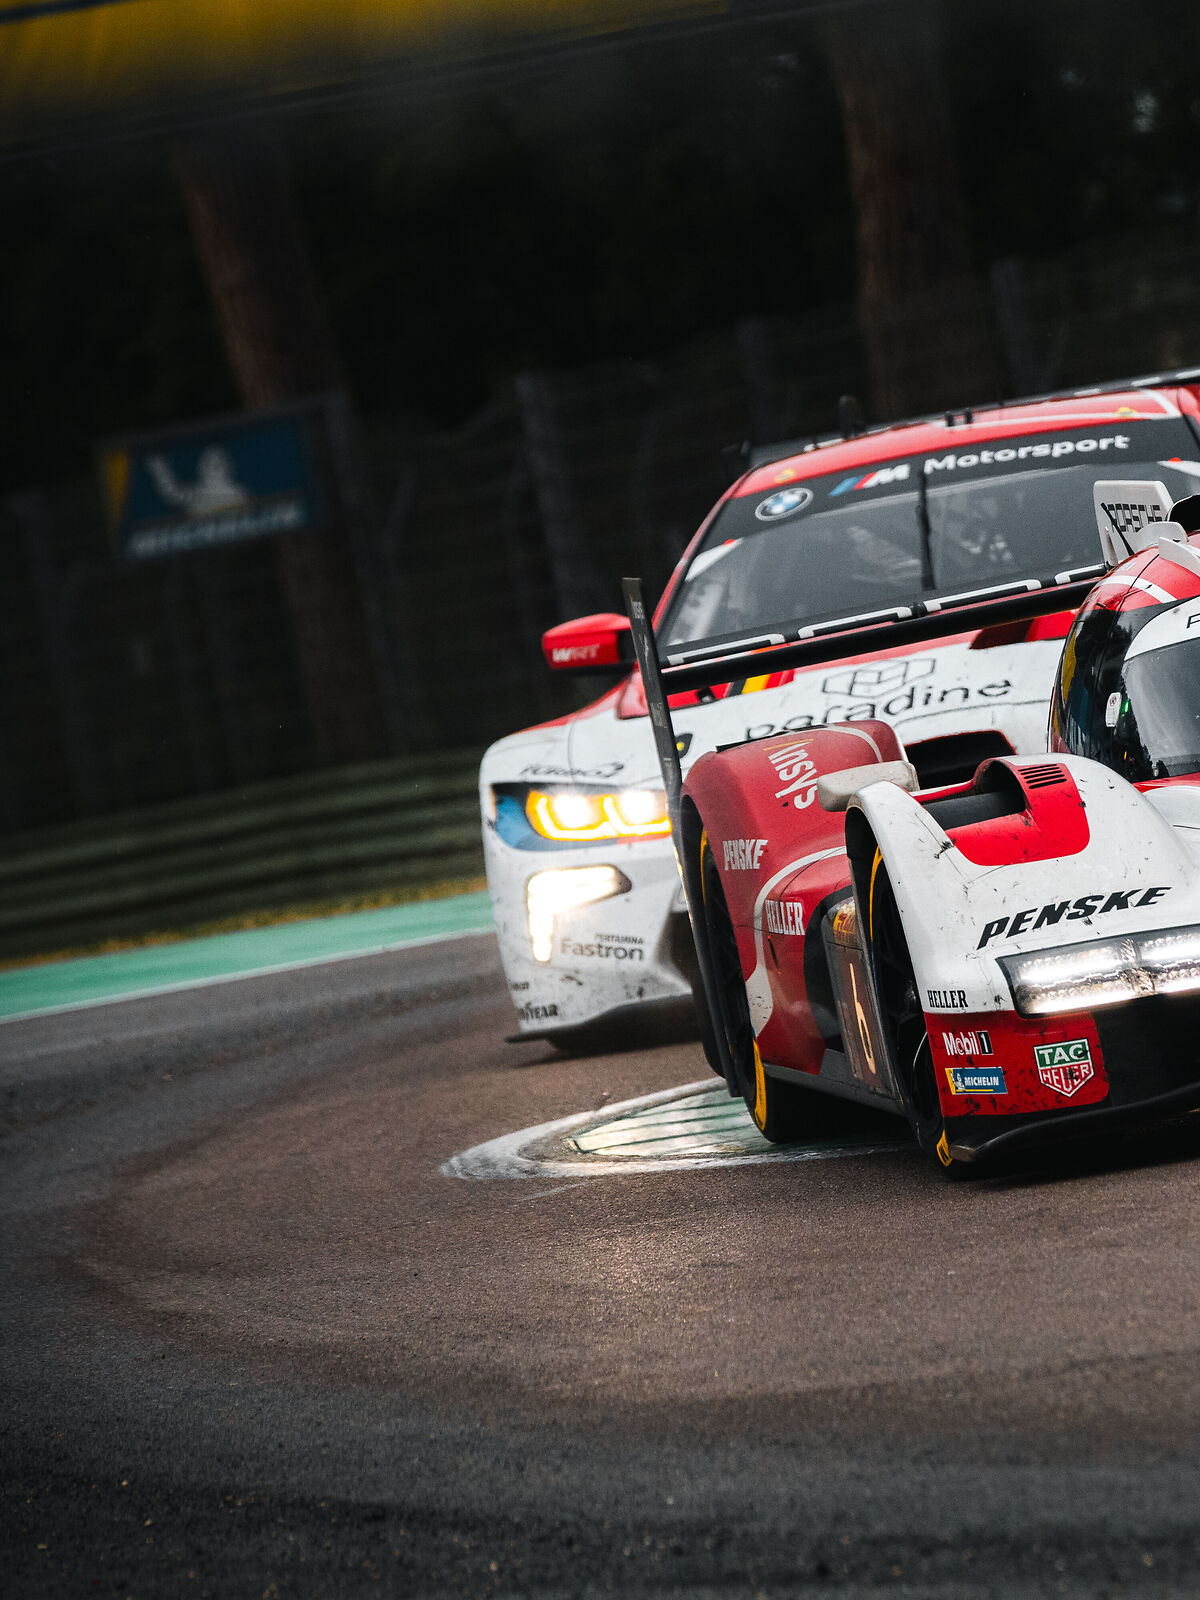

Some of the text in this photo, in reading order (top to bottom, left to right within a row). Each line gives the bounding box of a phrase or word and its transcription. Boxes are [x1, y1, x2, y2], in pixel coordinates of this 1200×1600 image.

[923, 434, 1131, 476] Motorsport
[552, 643, 600, 663] WRT
[745, 678, 1014, 741] paradine
[721, 838, 769, 872] PENSKE
[764, 899, 806, 937] HELLER
[976, 886, 1173, 951] PENSKE
[559, 936, 646, 962] Fastron
[926, 989, 969, 1008] HELLER
[941, 1031, 980, 1056] Mobil
[1038, 1043, 1087, 1066] TAG
[963, 1076, 1000, 1088] MICHELIN
[1041, 1063, 1090, 1093] HEUER
